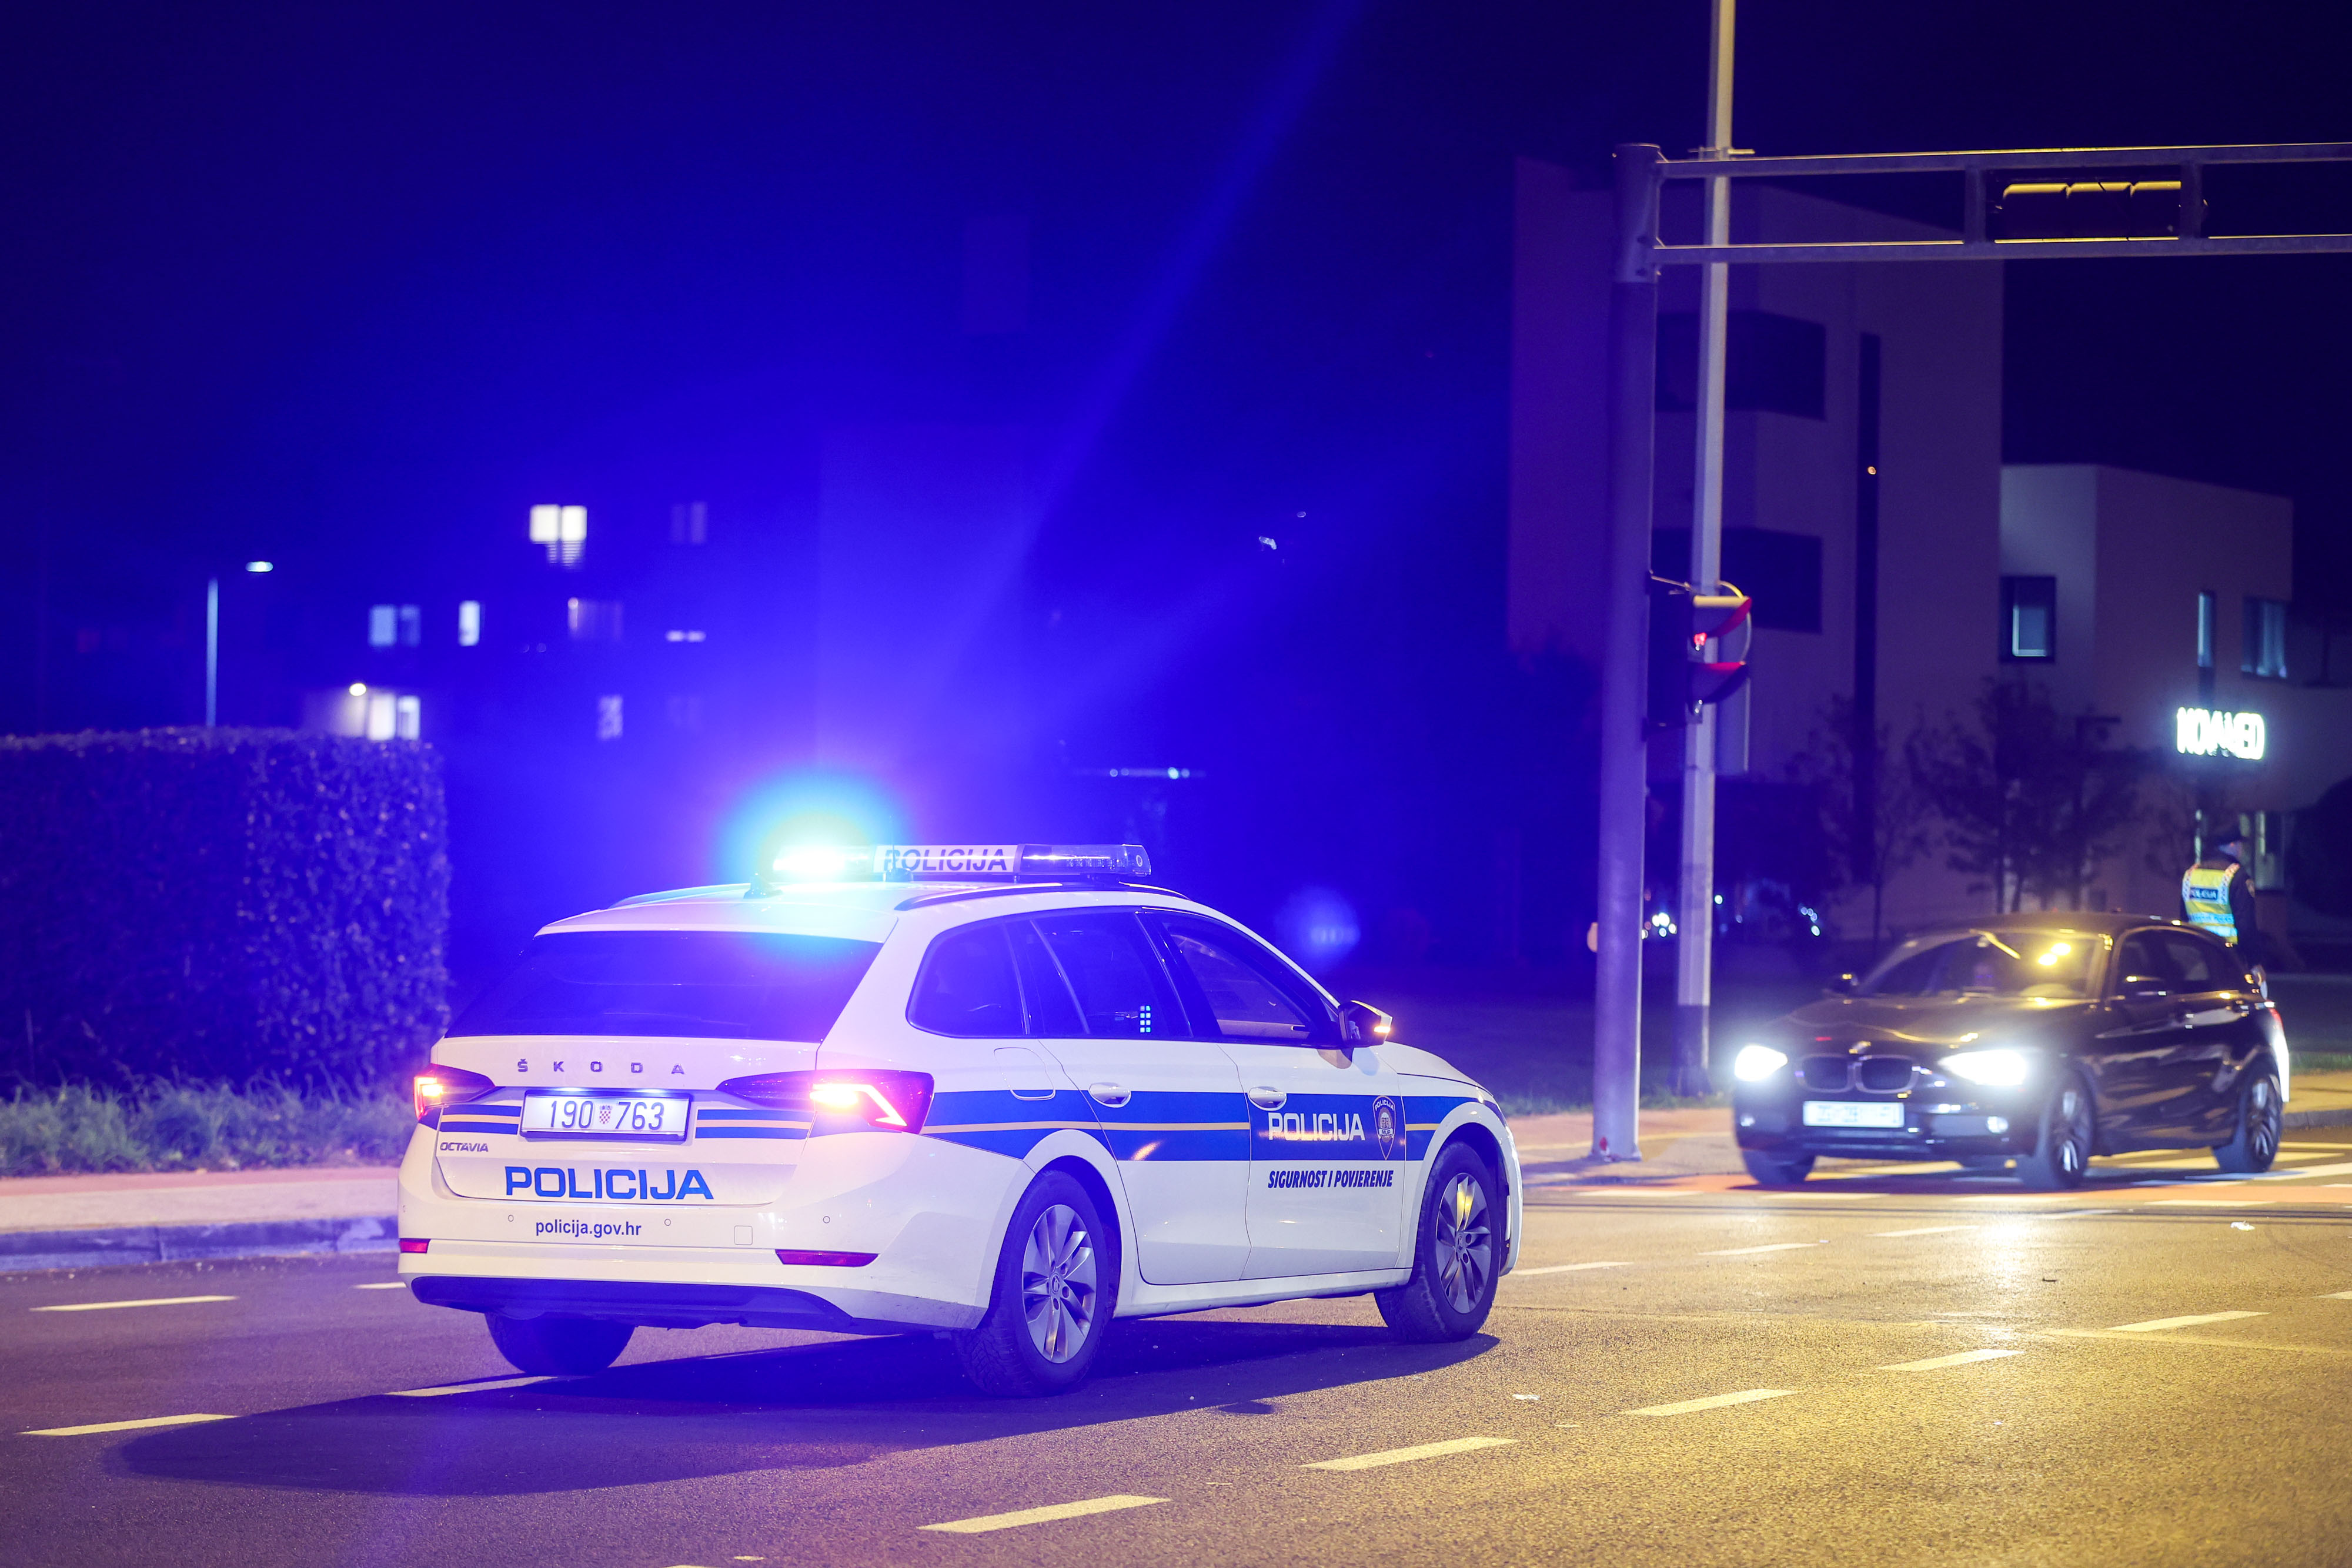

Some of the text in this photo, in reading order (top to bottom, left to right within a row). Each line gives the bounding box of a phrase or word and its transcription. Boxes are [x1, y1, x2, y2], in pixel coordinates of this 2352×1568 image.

[884, 848, 1007, 871] POLICIJA
[550, 1100, 665, 1131] 190 763
[1375, 1099, 1394, 1111] POLICIJA
[1268, 1112, 1365, 1141] POLICIJA
[440, 1142, 489, 1152] OCTAVIA
[505, 1166, 714, 1200] POLICIJA
[1268, 1170, 1394, 1188] SIGURNOST I POVJERENJE
[536, 1219, 642, 1238] policija.gov.hr
